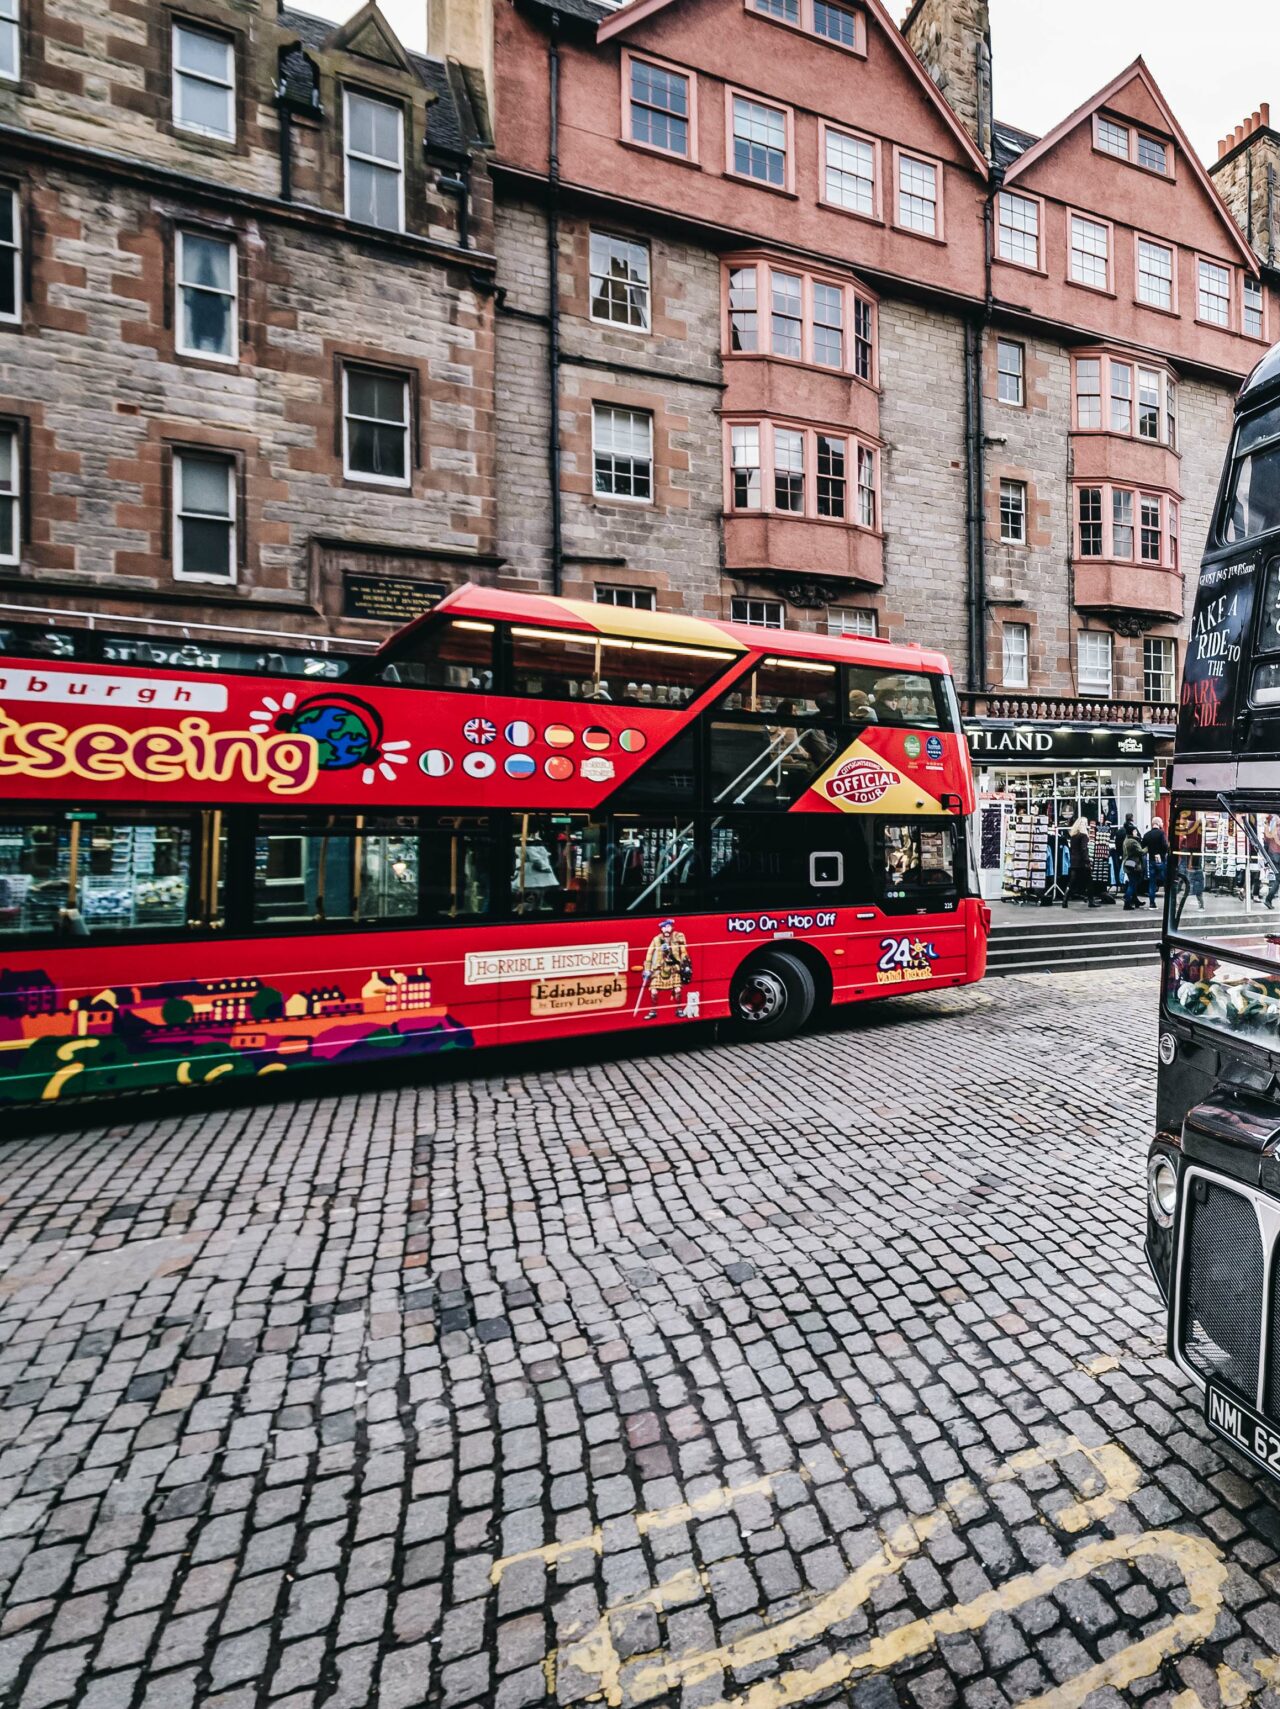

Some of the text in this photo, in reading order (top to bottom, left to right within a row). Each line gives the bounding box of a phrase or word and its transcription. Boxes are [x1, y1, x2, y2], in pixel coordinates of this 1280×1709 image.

[1188, 593, 1238, 643] TAKE A
[1196, 629, 1241, 662] RIDE TO
[1207, 660, 1225, 677] THE
[1182, 677, 1218, 706] DARK
[967, 731, 1053, 750] TLAND
[832, 772, 898, 795] OFFICIAL
[854, 788, 884, 802] TOUR
[728, 918, 755, 932] Hop
[760, 916, 777, 930] On
[788, 915, 813, 929] Hop
[816, 912, 836, 926] Off
[476, 951, 619, 976] HORRIBLE HISTORIES
[880, 938, 913, 969] 24
[536, 978, 623, 1000] Edinburgh
[550, 999, 574, 1009] Terry
[1212, 1393, 1249, 1446] NML
